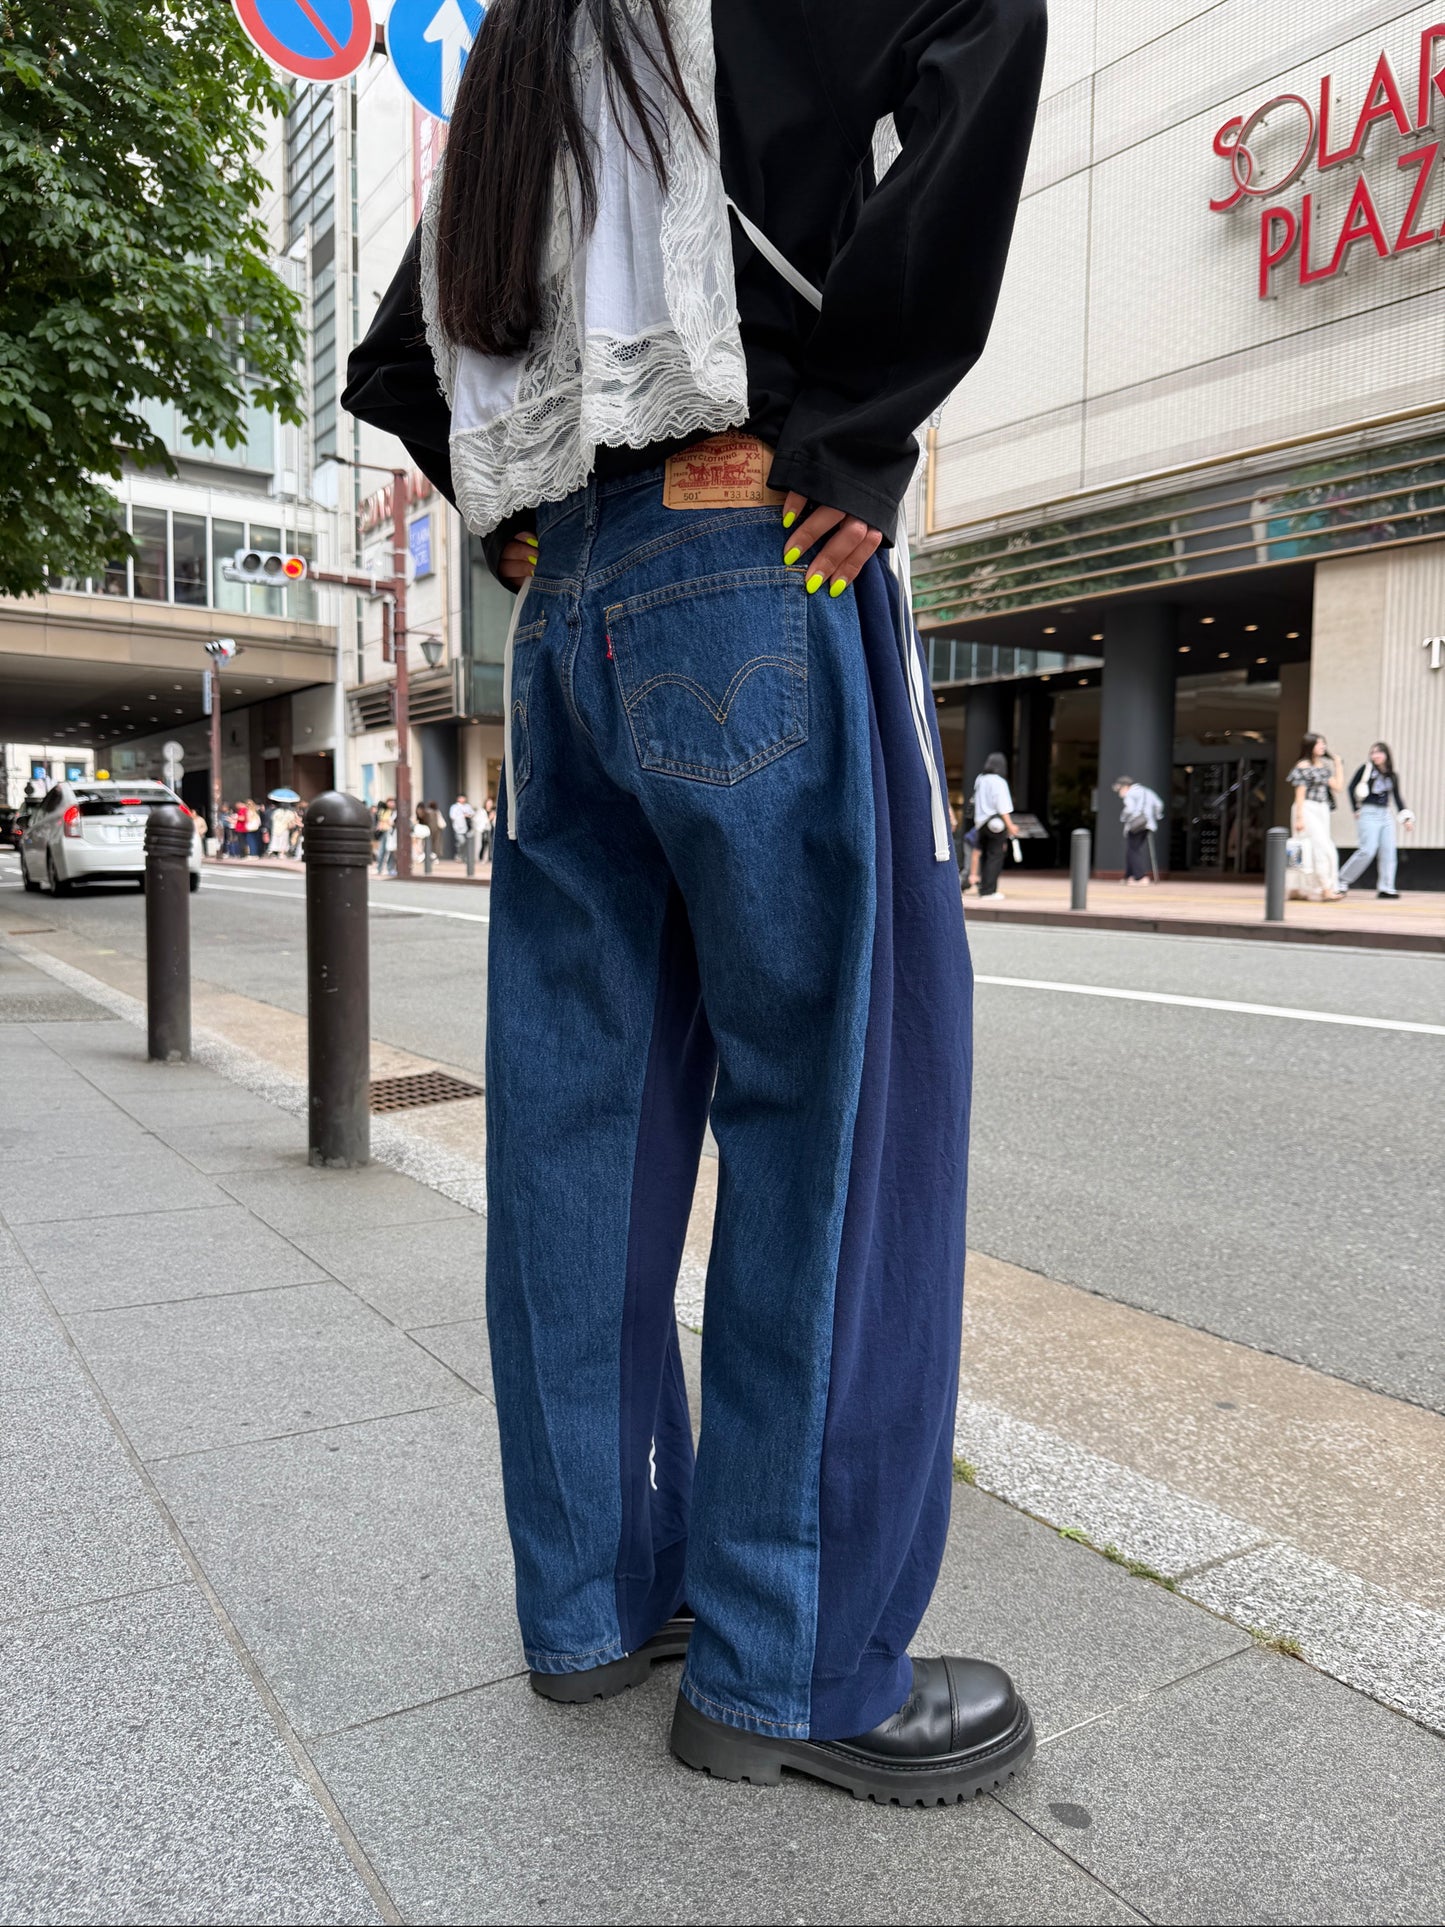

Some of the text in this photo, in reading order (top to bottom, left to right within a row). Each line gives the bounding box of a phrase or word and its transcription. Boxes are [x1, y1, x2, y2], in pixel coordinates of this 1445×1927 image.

[1259, 141, 1445, 300] PLAZ
[671, 452, 737, 463] QUALITY CLOTHING
